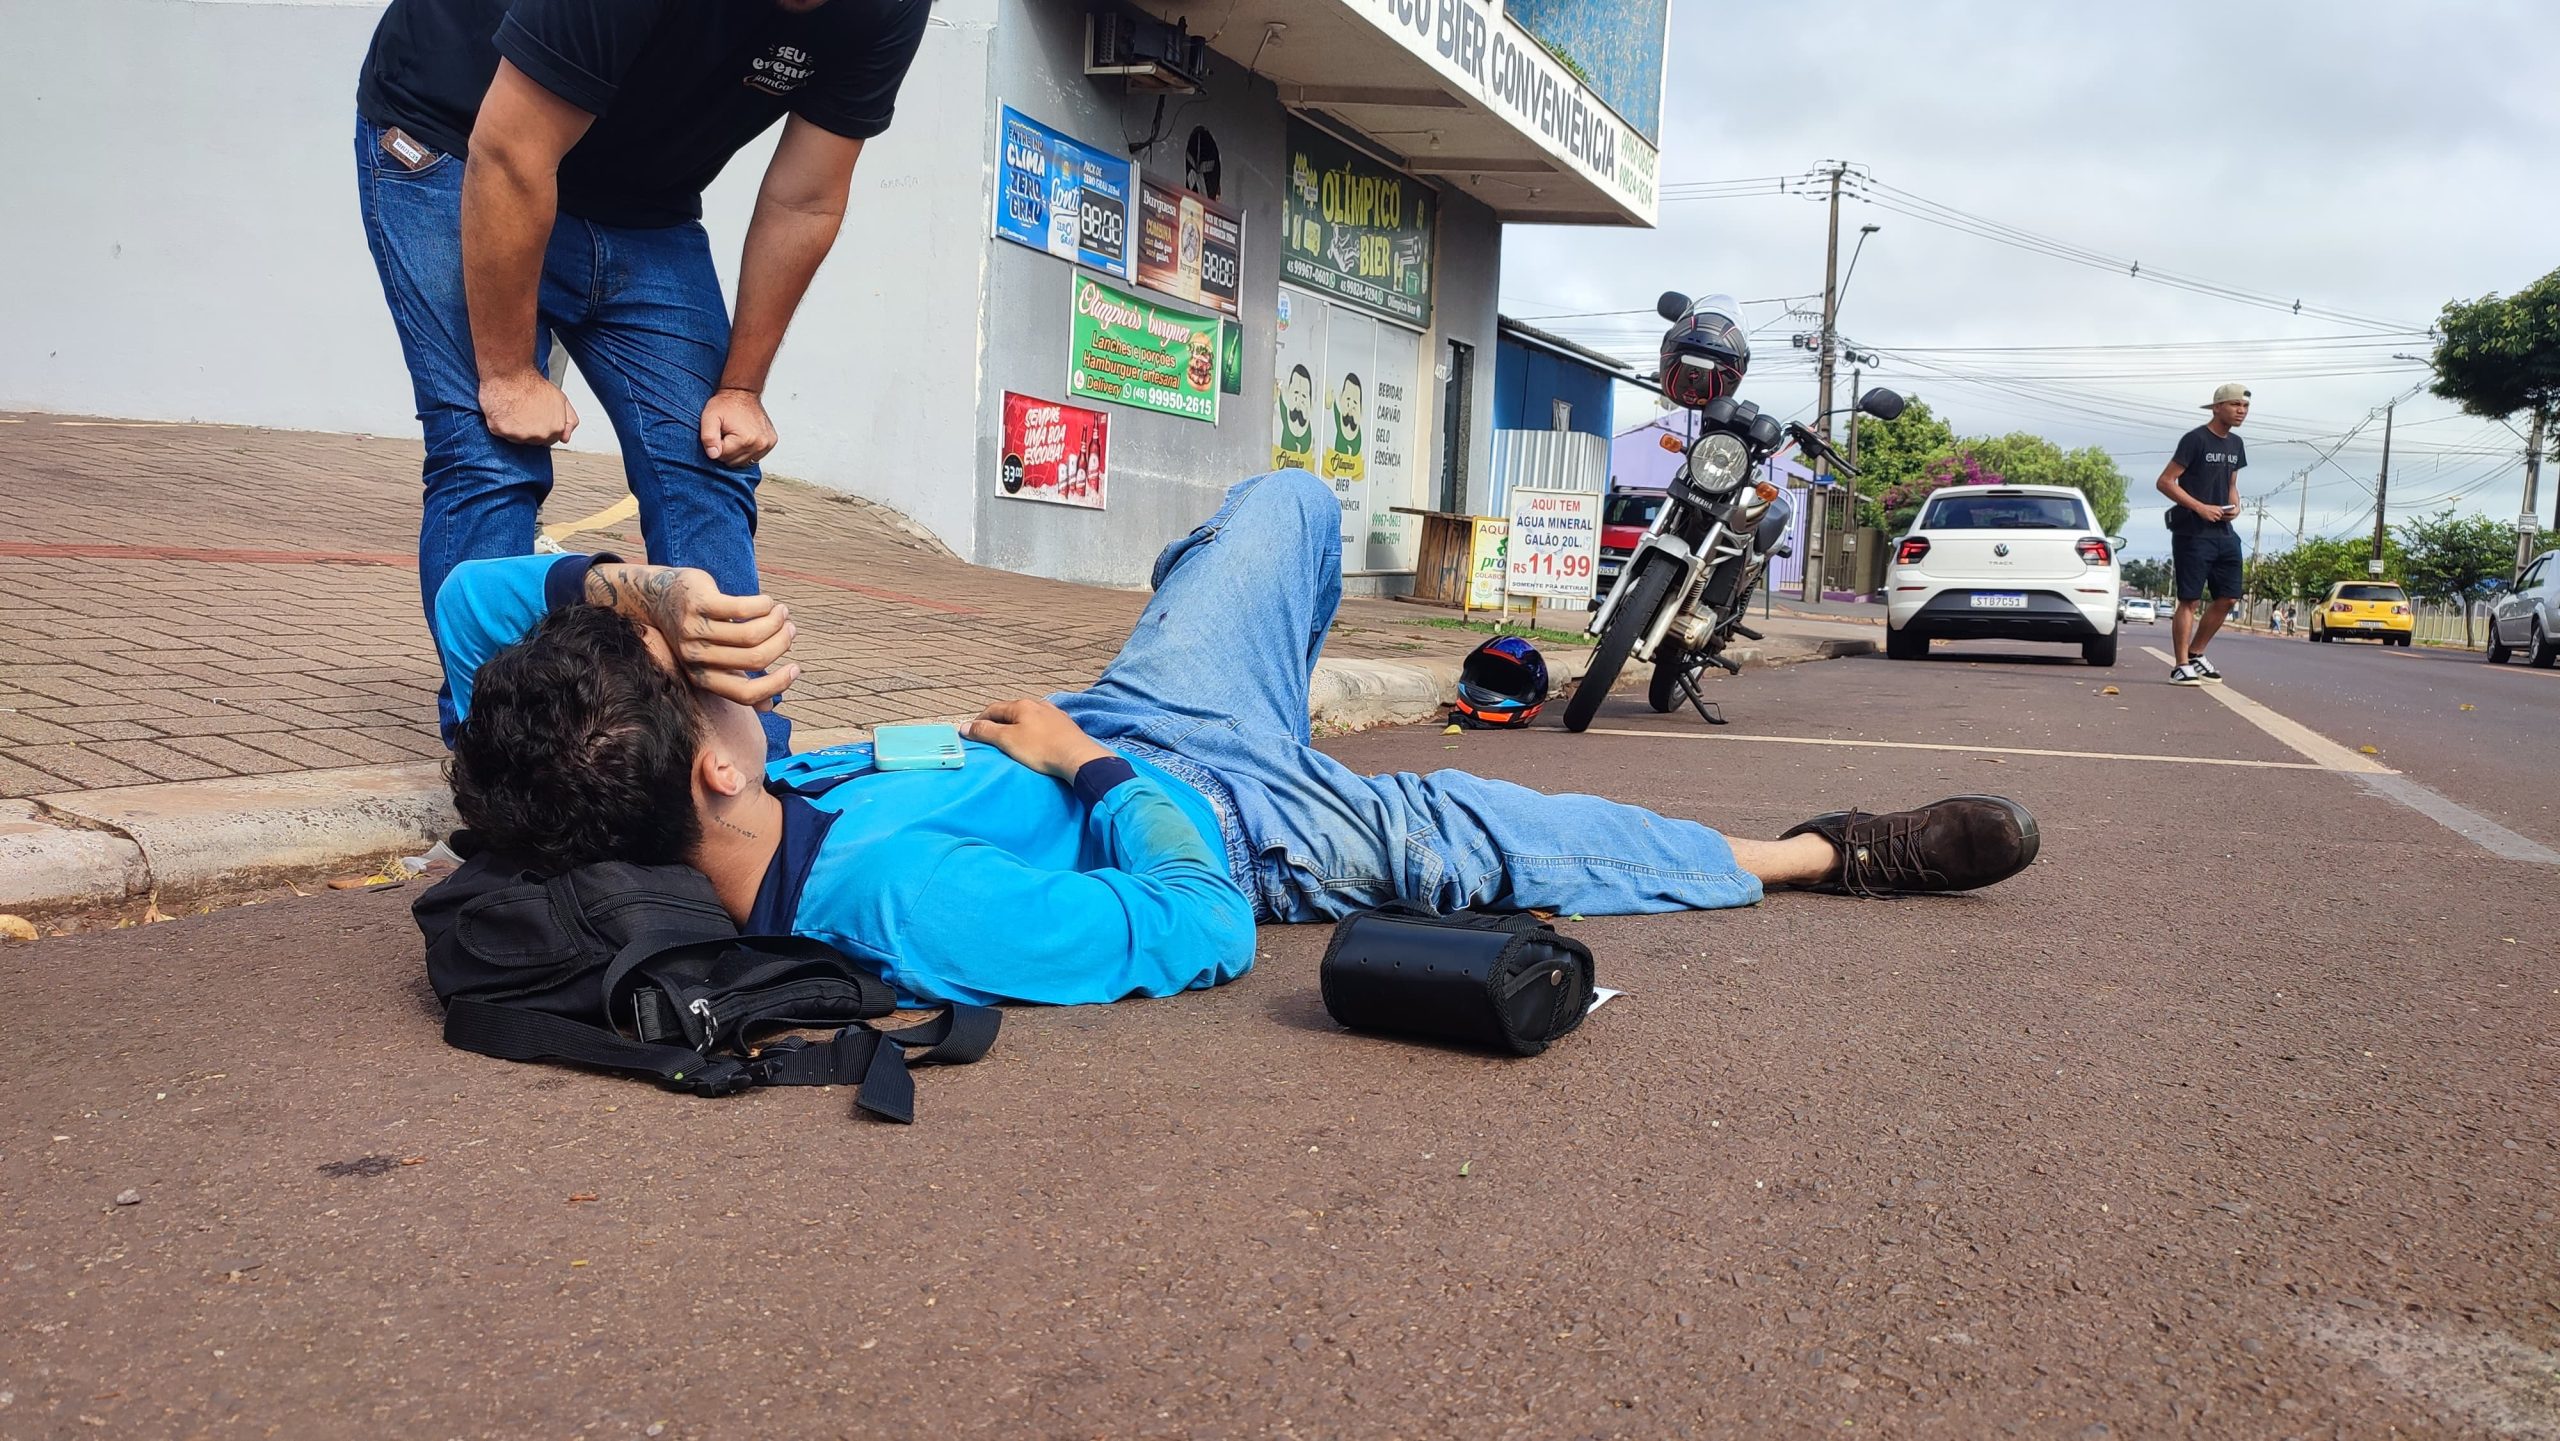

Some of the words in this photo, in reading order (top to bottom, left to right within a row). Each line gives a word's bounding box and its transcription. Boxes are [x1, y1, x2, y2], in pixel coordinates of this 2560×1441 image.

[776, 46, 806, 63] SEU
[1437, 0, 1486, 86] BIER
[1492, 32, 1615, 182] CONVENIÊNCIA
[1006, 125, 1031, 149] ENTRE
[1007, 142, 1045, 177] CLIMA
[1009, 170, 1042, 202] ZERO
[1322, 160, 1400, 229] OLÍMPICO
[1009, 196, 1042, 226] GRAU
[1143, 189, 1177, 217] Burguesa
[1359, 234, 1391, 277] BIER
[1147, 308, 1190, 348] burguer
[1091, 330, 1132, 357] Lanches
[1132, 346, 1140, 359] e
[1139, 347, 1177, 369] porções
[1082, 351, 1142, 381] Hamburguer
[1142, 369, 1182, 390] artesanal
[1086, 375, 1123, 399] Delivery
[1132, 386, 1148, 401] (45)
[1148, 388, 1212, 416] 99950-2615
[1378, 382, 1403, 401] BEBIDAS
[1025, 407, 1060, 428] SEMPRE
[1376, 404, 1401, 424] CARVÃO
[1024, 426, 1048, 447] UMA
[1047, 424, 1067, 443] BOA
[1375, 427, 1391, 444] GELO
[1023, 443, 1066, 466] ESCOLHA!
[1374, 447, 1401, 468] ESSÊNCIA
[1335, 478, 1350, 492] BIER
[1339, 497, 1360, 511] NIÊNCIA
[1531, 498, 1556, 511] AQUI
[1560, 500, 1581, 512] TEM
[1687, 492, 1713, 511] YAMAHA
[1548, 517, 1593, 531] MINERAL
[1524, 533, 1559, 548] GALÃO
[1480, 557, 1507, 571] pro
[1529, 552, 1591, 581] 11,99
[1512, 581, 1544, 589] SOMENTE
